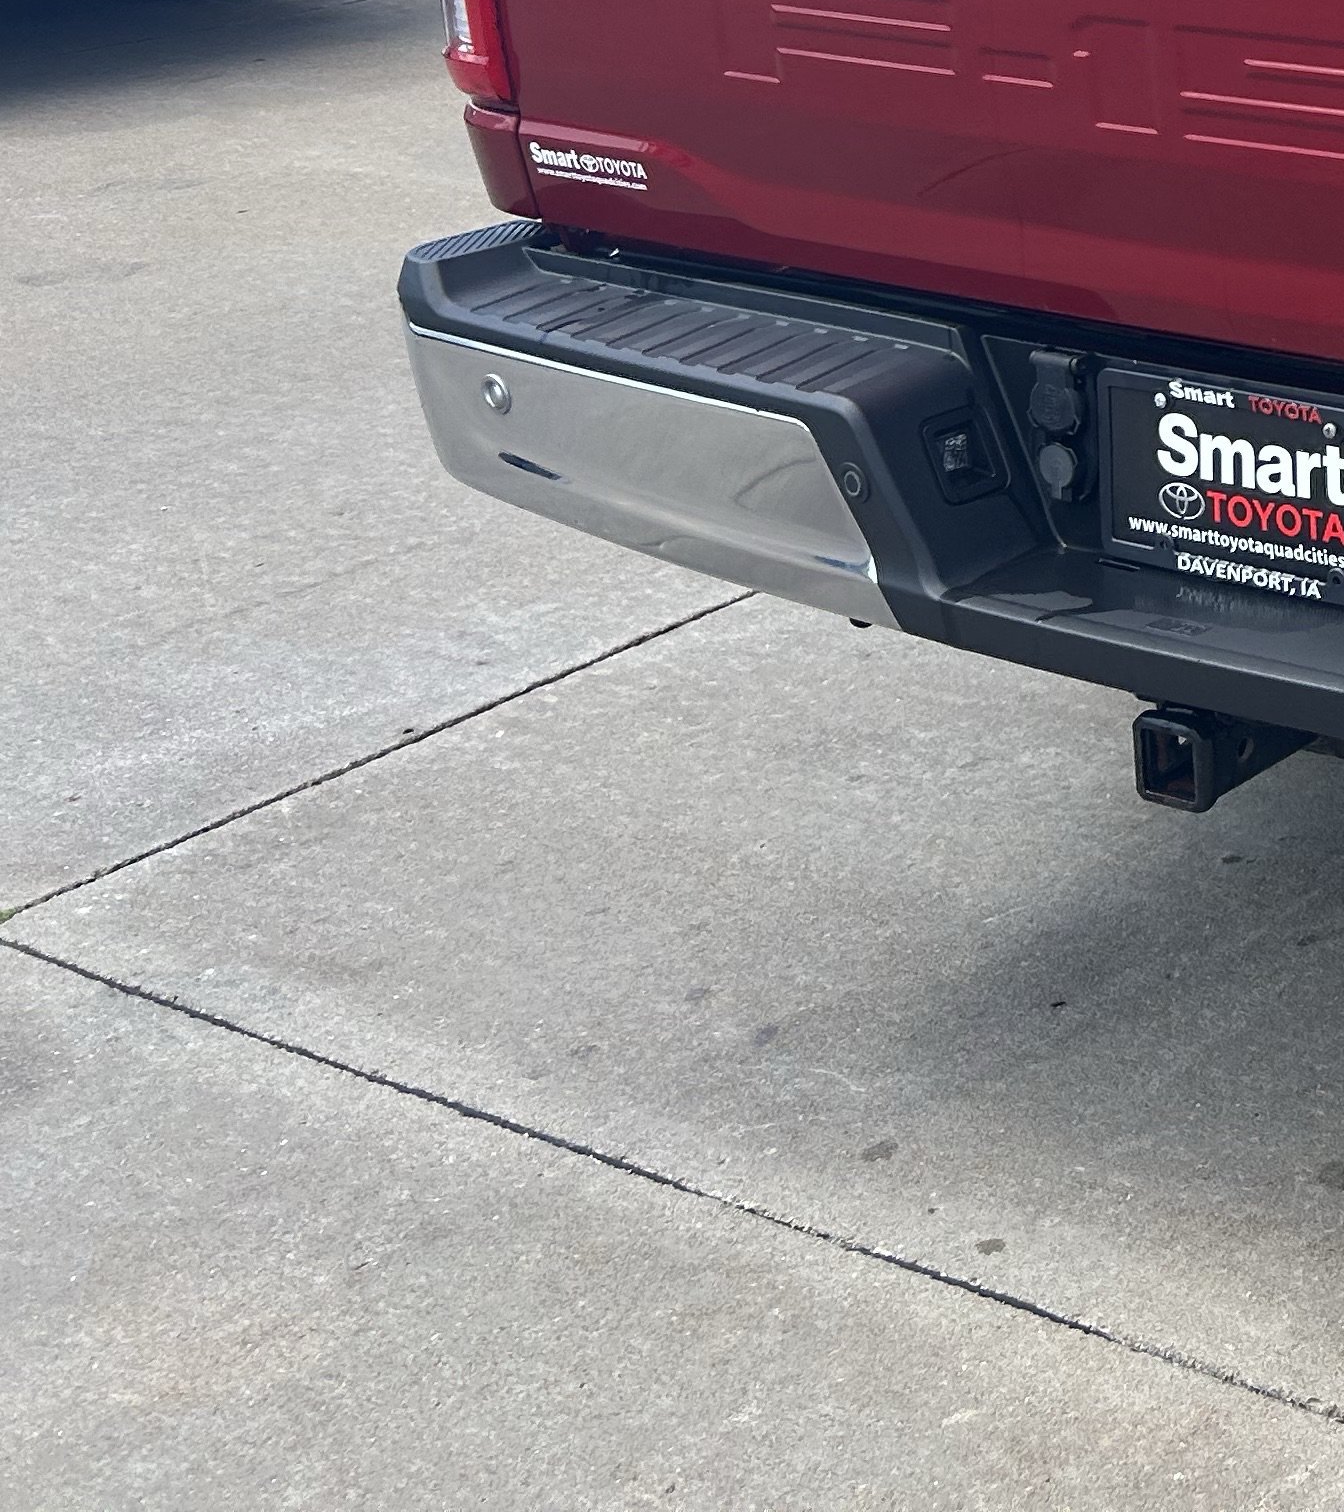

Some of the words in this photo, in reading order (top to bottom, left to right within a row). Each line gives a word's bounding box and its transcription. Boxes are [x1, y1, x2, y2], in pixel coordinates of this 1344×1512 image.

[529, 141, 581, 170] Smart
[596, 157, 648, 180] TOYOTA
[1168, 380, 1236, 409] Smart
[1248, 395, 1323, 425] TOYOTA
[1177, 554, 1297, 596] DAVENPORT,
[1301, 578, 1323, 599] IA
